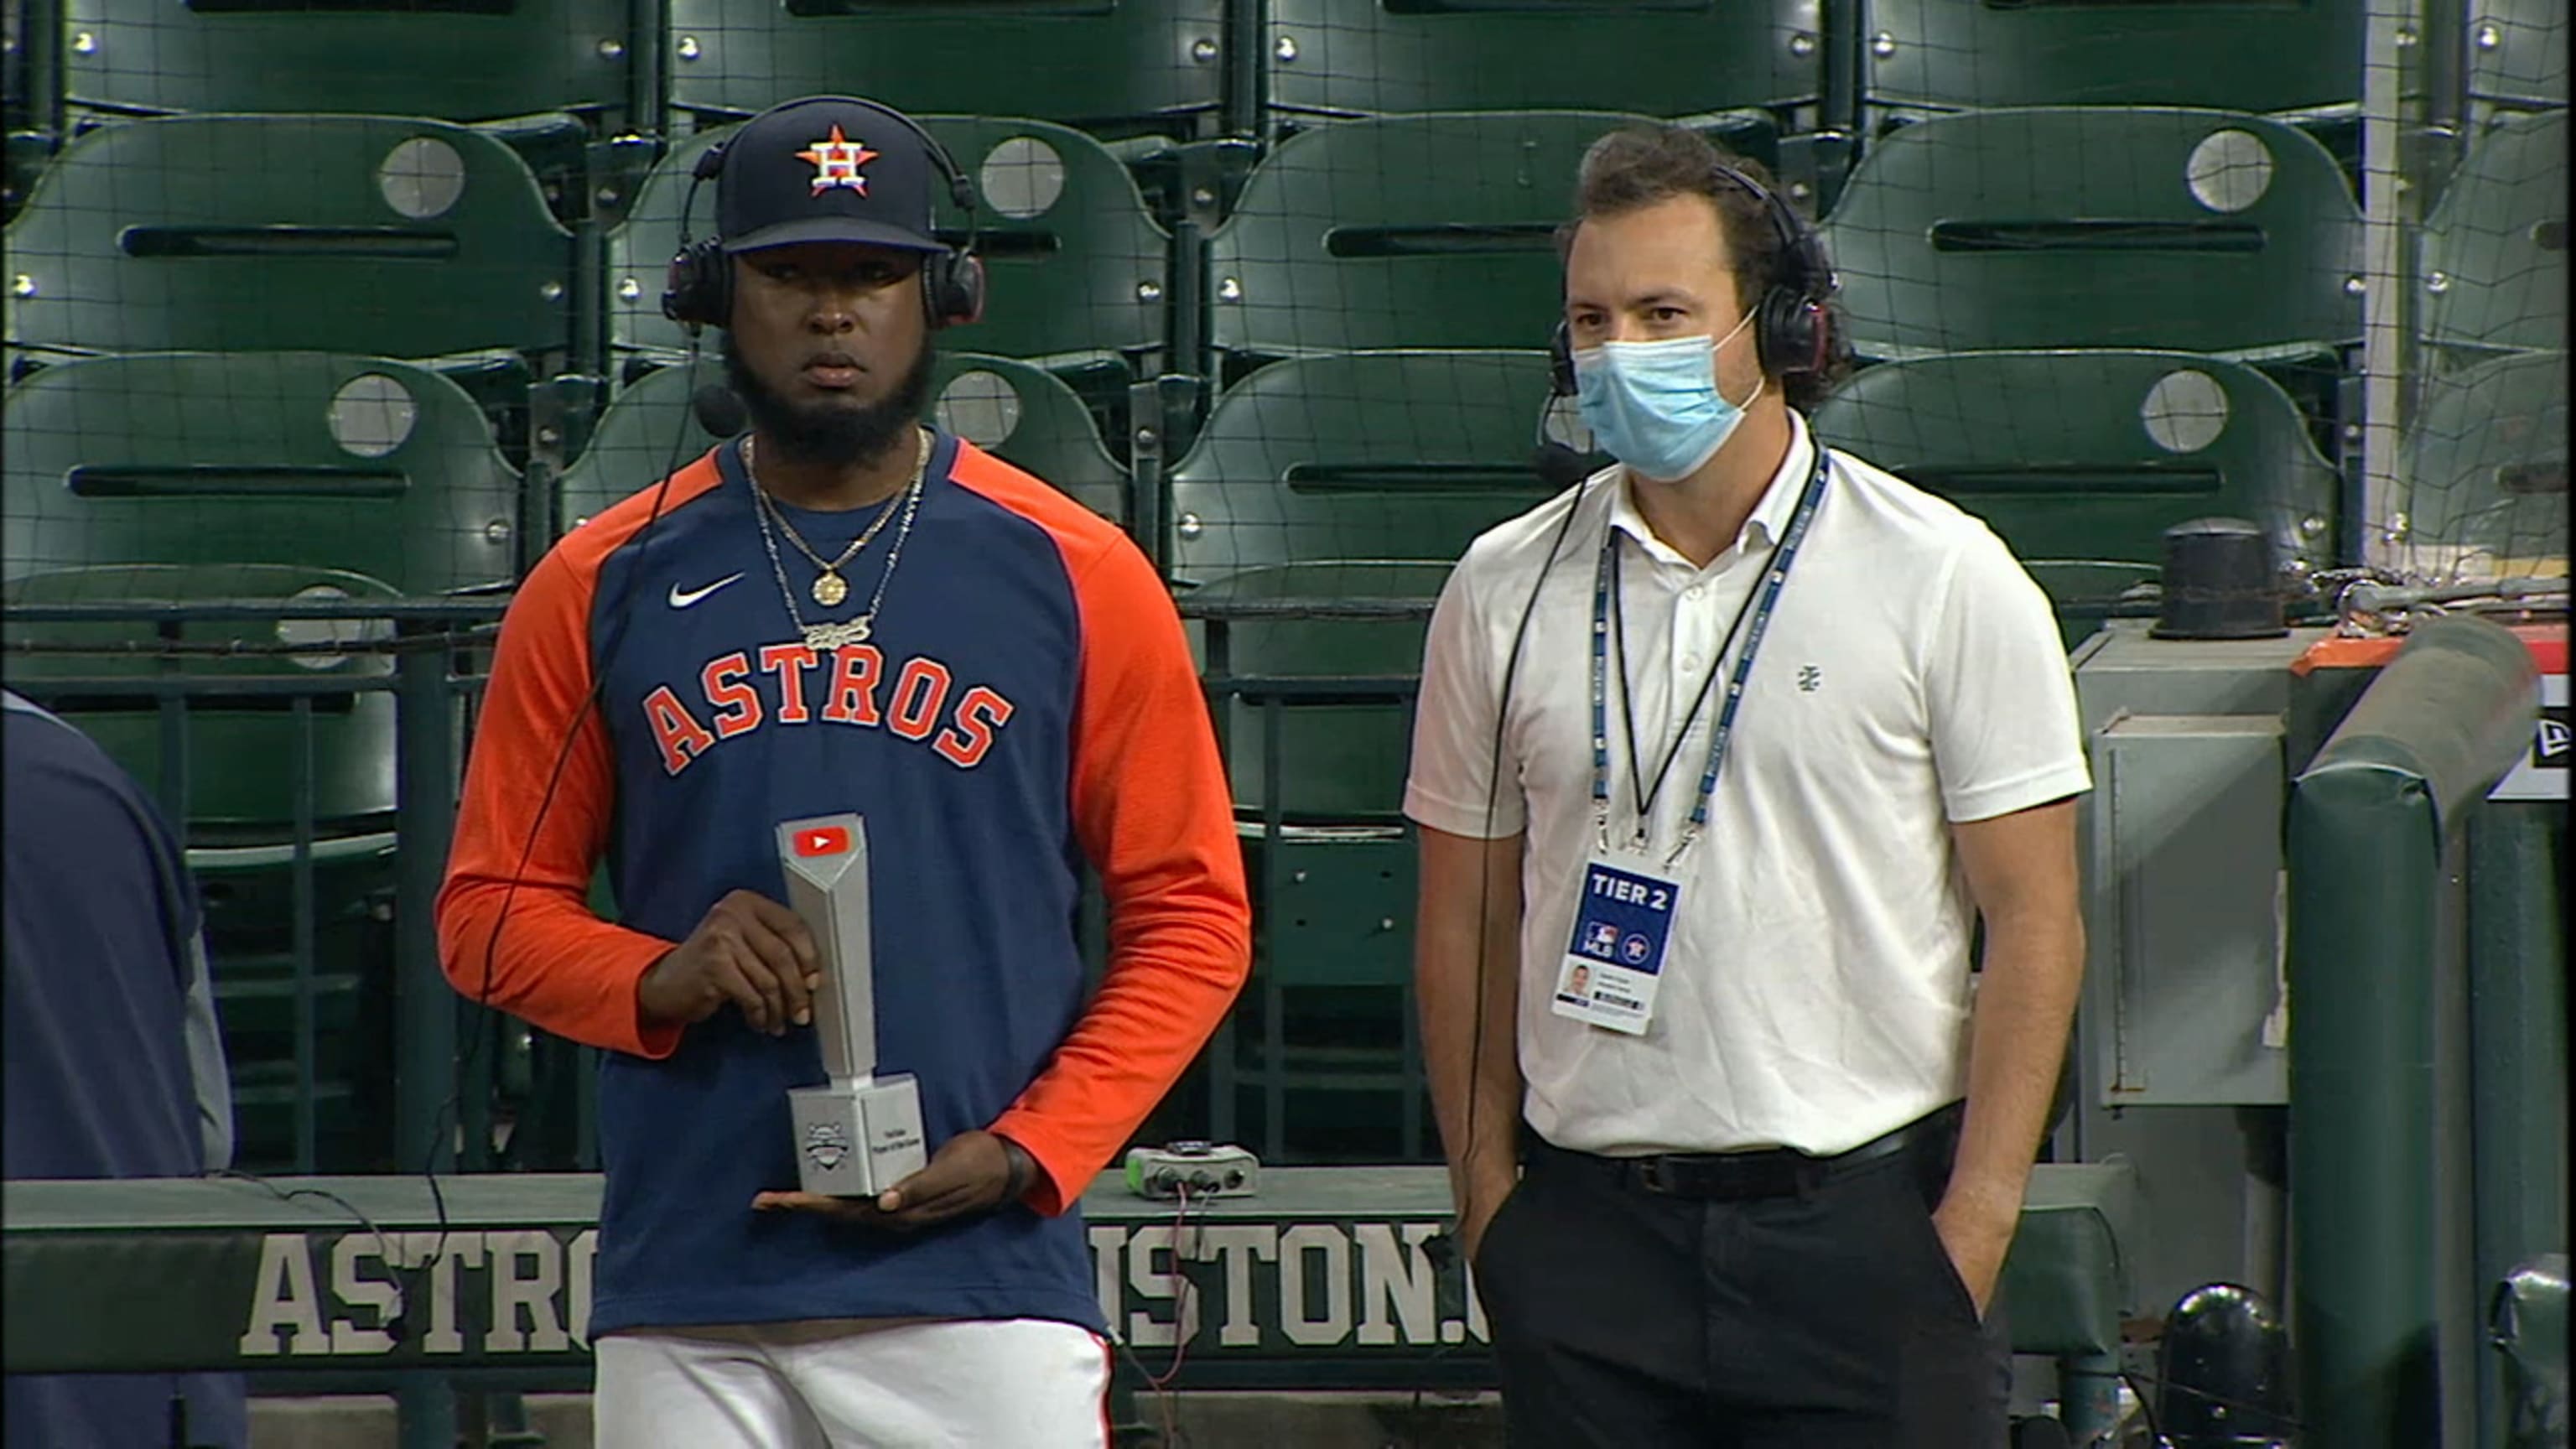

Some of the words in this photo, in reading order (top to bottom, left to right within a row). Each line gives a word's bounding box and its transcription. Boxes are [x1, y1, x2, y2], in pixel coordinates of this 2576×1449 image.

[810, 143, 865, 187] H
[642, 642, 1014, 776] ASTROS
[1592, 873, 1648, 906] TIER
[1650, 889, 1670, 911] 2
